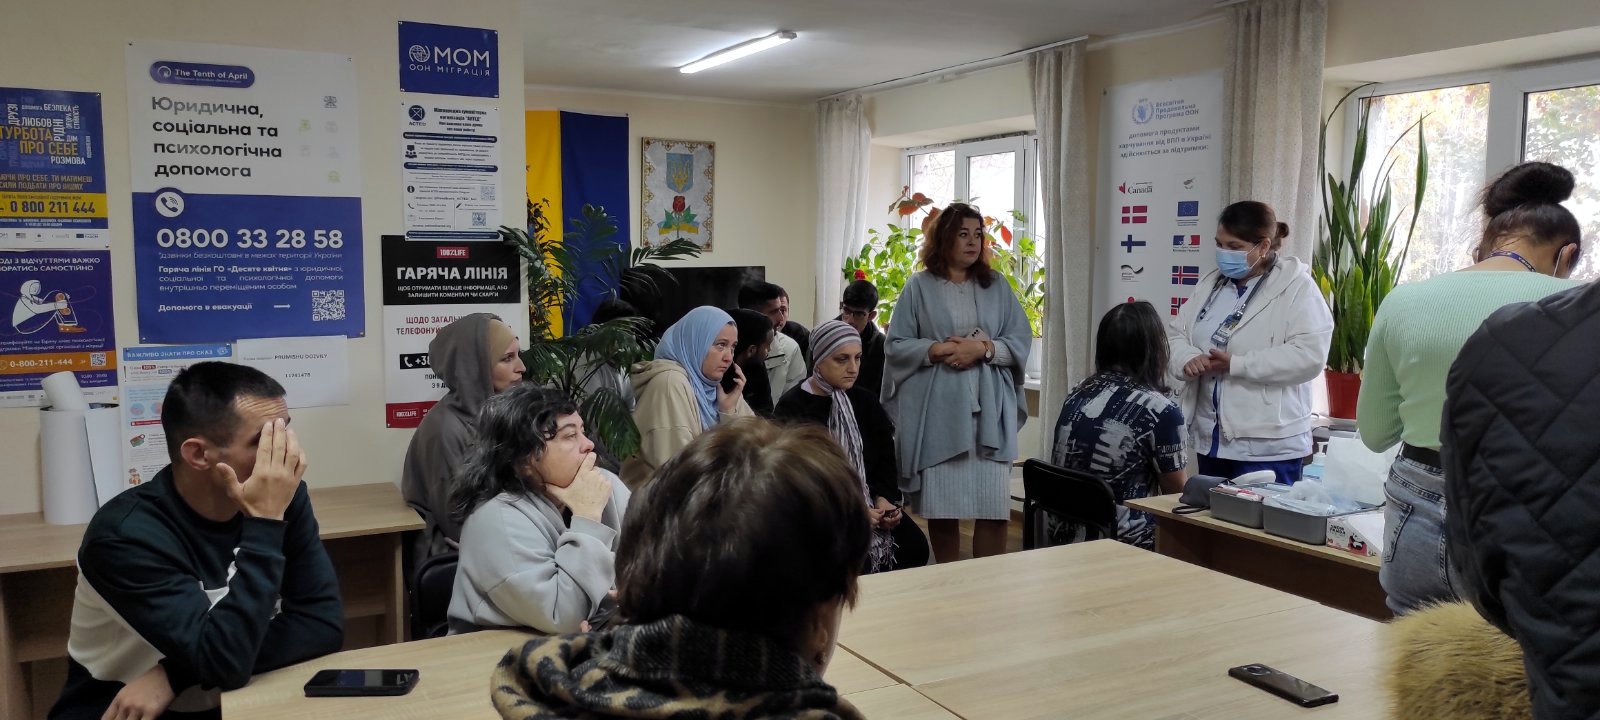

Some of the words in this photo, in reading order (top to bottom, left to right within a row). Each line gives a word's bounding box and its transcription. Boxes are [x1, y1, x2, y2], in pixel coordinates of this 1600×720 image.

[434, 46, 489, 68] МОМ
[437, 66, 489, 76] МІГРАЦІЯ
[152, 97, 264, 118] Юридична,
[8, 104, 20, 126] ДРУЗІ
[21, 117, 52, 127] ЛЮБОВ
[153, 120, 251, 135] соціальна
[257, 125, 278, 137] та
[0, 126, 53, 140] ТУРБОТА
[53, 119, 66, 141] РІДНІ
[1160, 126, 1200, 136] продуктами
[20, 141, 44, 154] ПРО
[48, 142, 78, 155] СЕБЕ
[154, 143, 282, 158] психологічна
[51, 156, 86, 165] РОЗМОВА
[155, 165, 251, 177] допомога
[1128, 186, 1152, 194] Canada
[10, 201, 17, 212] 0
[22, 201, 44, 212] 800
[49, 202, 68, 213] 211
[73, 202, 95, 213] 444
[157, 228, 228, 248] 0800
[237, 229, 268, 248] 33
[276, 230, 306, 248] 28
[314, 230, 343, 248] 58
[397, 267, 460, 280] ГАРЯЧА
[464, 267, 507, 280] ЛІНІЯ
[212, 303, 252, 311] евакуації
[10, 359, 72, 367] 0-800-211-444
